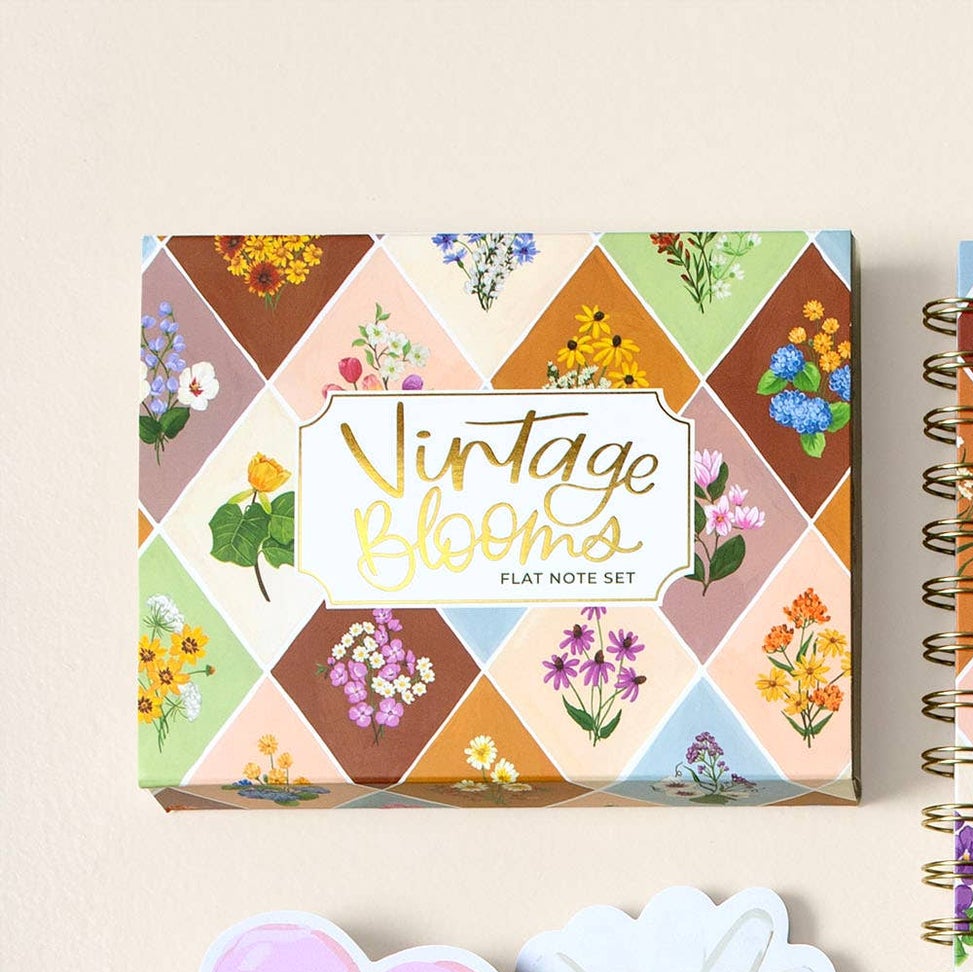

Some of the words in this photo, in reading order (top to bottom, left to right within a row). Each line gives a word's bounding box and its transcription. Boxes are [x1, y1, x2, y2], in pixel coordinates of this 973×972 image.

[340, 401, 659, 527] Vintage
[354, 486, 643, 592] Blooms
[500, 572, 545, 585] FLAT
[549, 572, 597, 584] NOTE
[604, 571, 636, 584] SET
